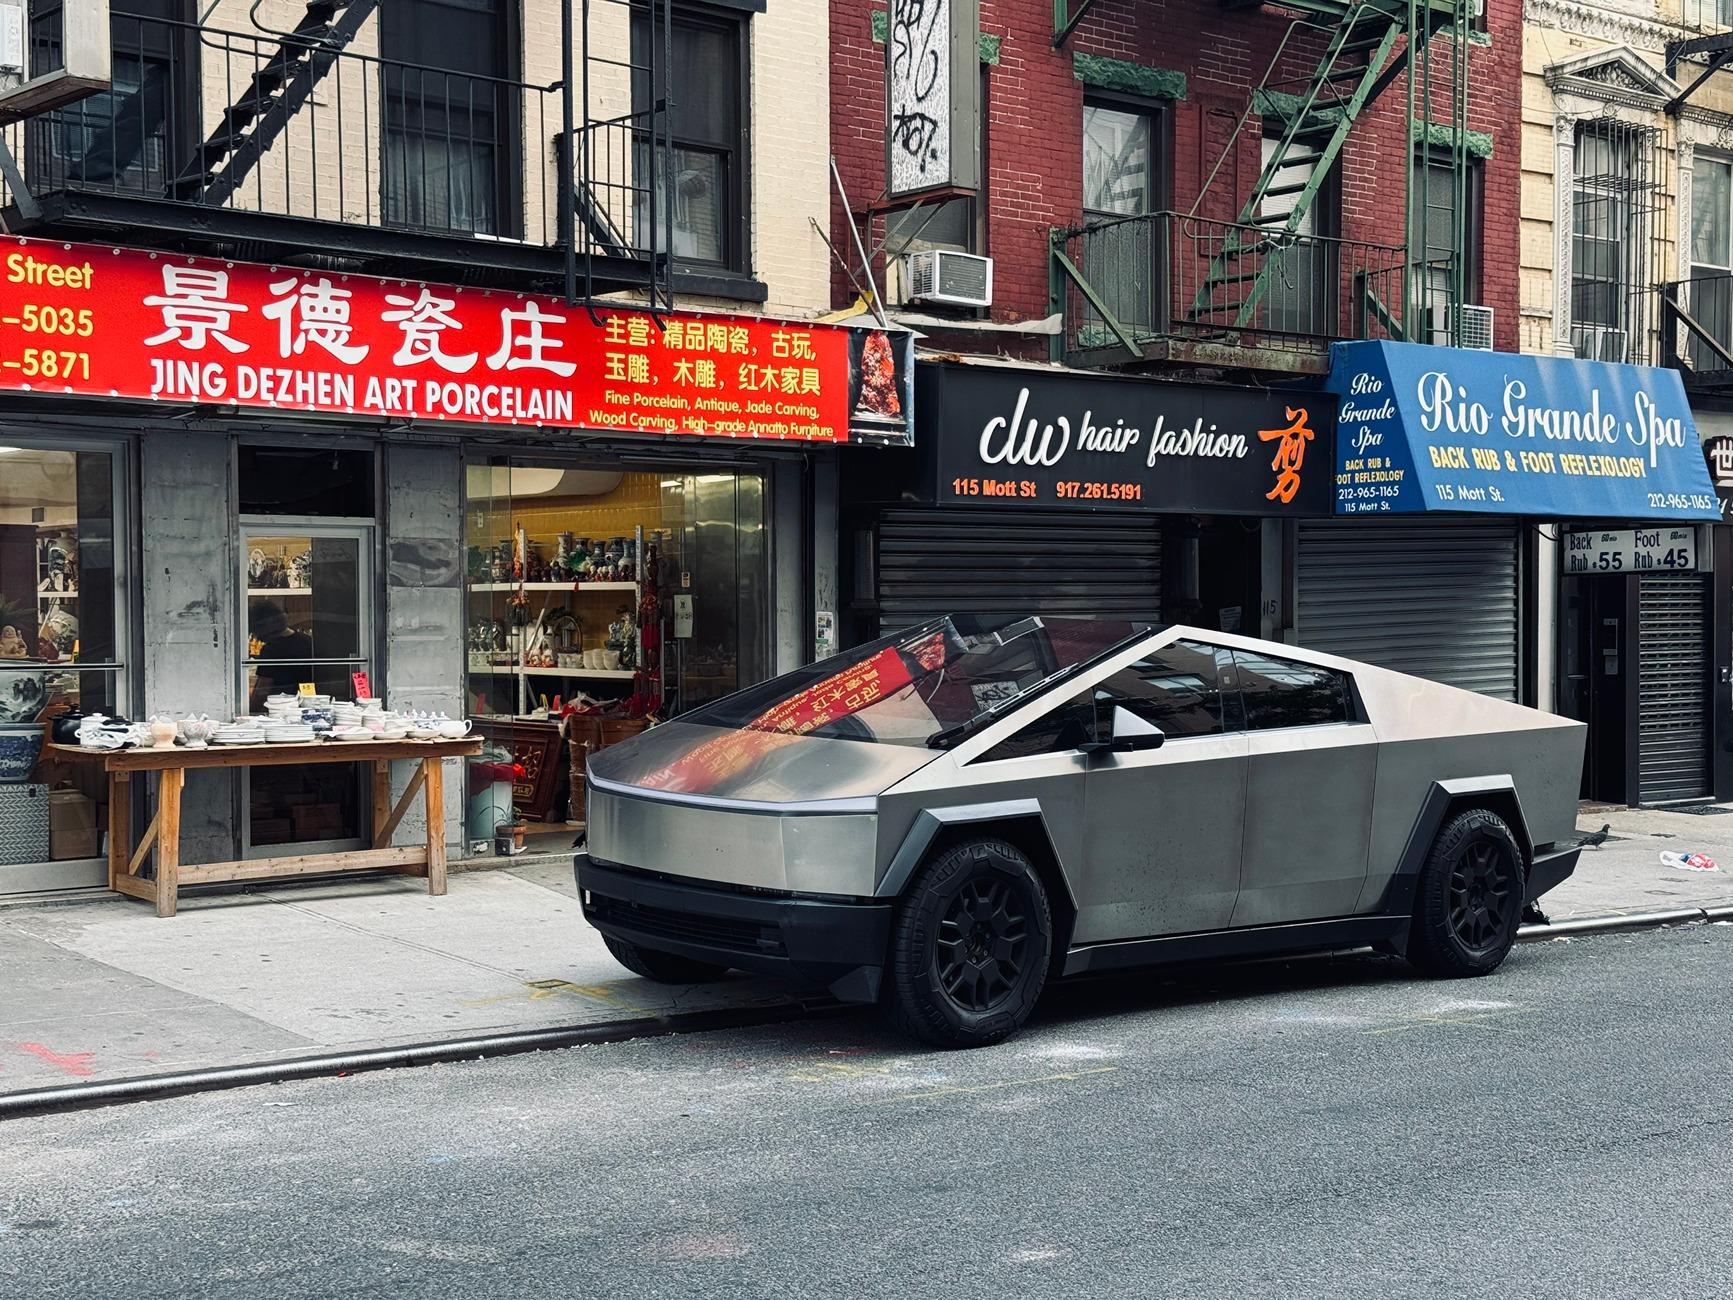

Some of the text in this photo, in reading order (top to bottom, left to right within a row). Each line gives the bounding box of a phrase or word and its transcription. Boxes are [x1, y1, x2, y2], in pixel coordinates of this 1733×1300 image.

[7, 253, 94, 289] Street
[0, 304, 94, 337] -5035
[143, 263, 577, 378] 景德瓷庄
[0, 348, 91, 380] -5871
[150, 358, 574, 422] JING DEZHEN ART PORCELAIN
[1350, 373, 1384, 396] Rio
[604, 390, 820, 419] Fine Porcelain, Antique, Jade Carving,
[1338, 398, 1397, 424] Grande
[589, 409, 834, 438] Wood Carving, High-grade Annatto Furniture
[1417, 371, 1688, 468] Rio Grande Spa
[1077, 410, 1141, 453] hair
[1146, 415, 1249, 468] fashion
[1351, 425, 1384, 455] Spa
[1345, 457, 1391, 470] BACK RUB &
[1428, 445, 1647, 478] BACK RUB & FOOT REFLEXOLOGY
[953, 478, 1037, 498] 115 Mott St
[1335, 469, 1404, 485] OOT REFLEXOLOGY
[1056, 481, 1141, 500] 917.261.5191
[1338, 485, 1399, 500] 212-965-1165
[1436, 484, 1505, 503] 115 Mott St.
[1648, 492, 1712, 510] 212-965-1165
[1344, 500, 1391, 512] 115 Mott St.
[1569, 533, 1593, 551] Back
[1634, 530, 1660, 548] Foot
[1571, 553, 1588, 572] Rub
[1634, 551, 1653, 569] Rub
